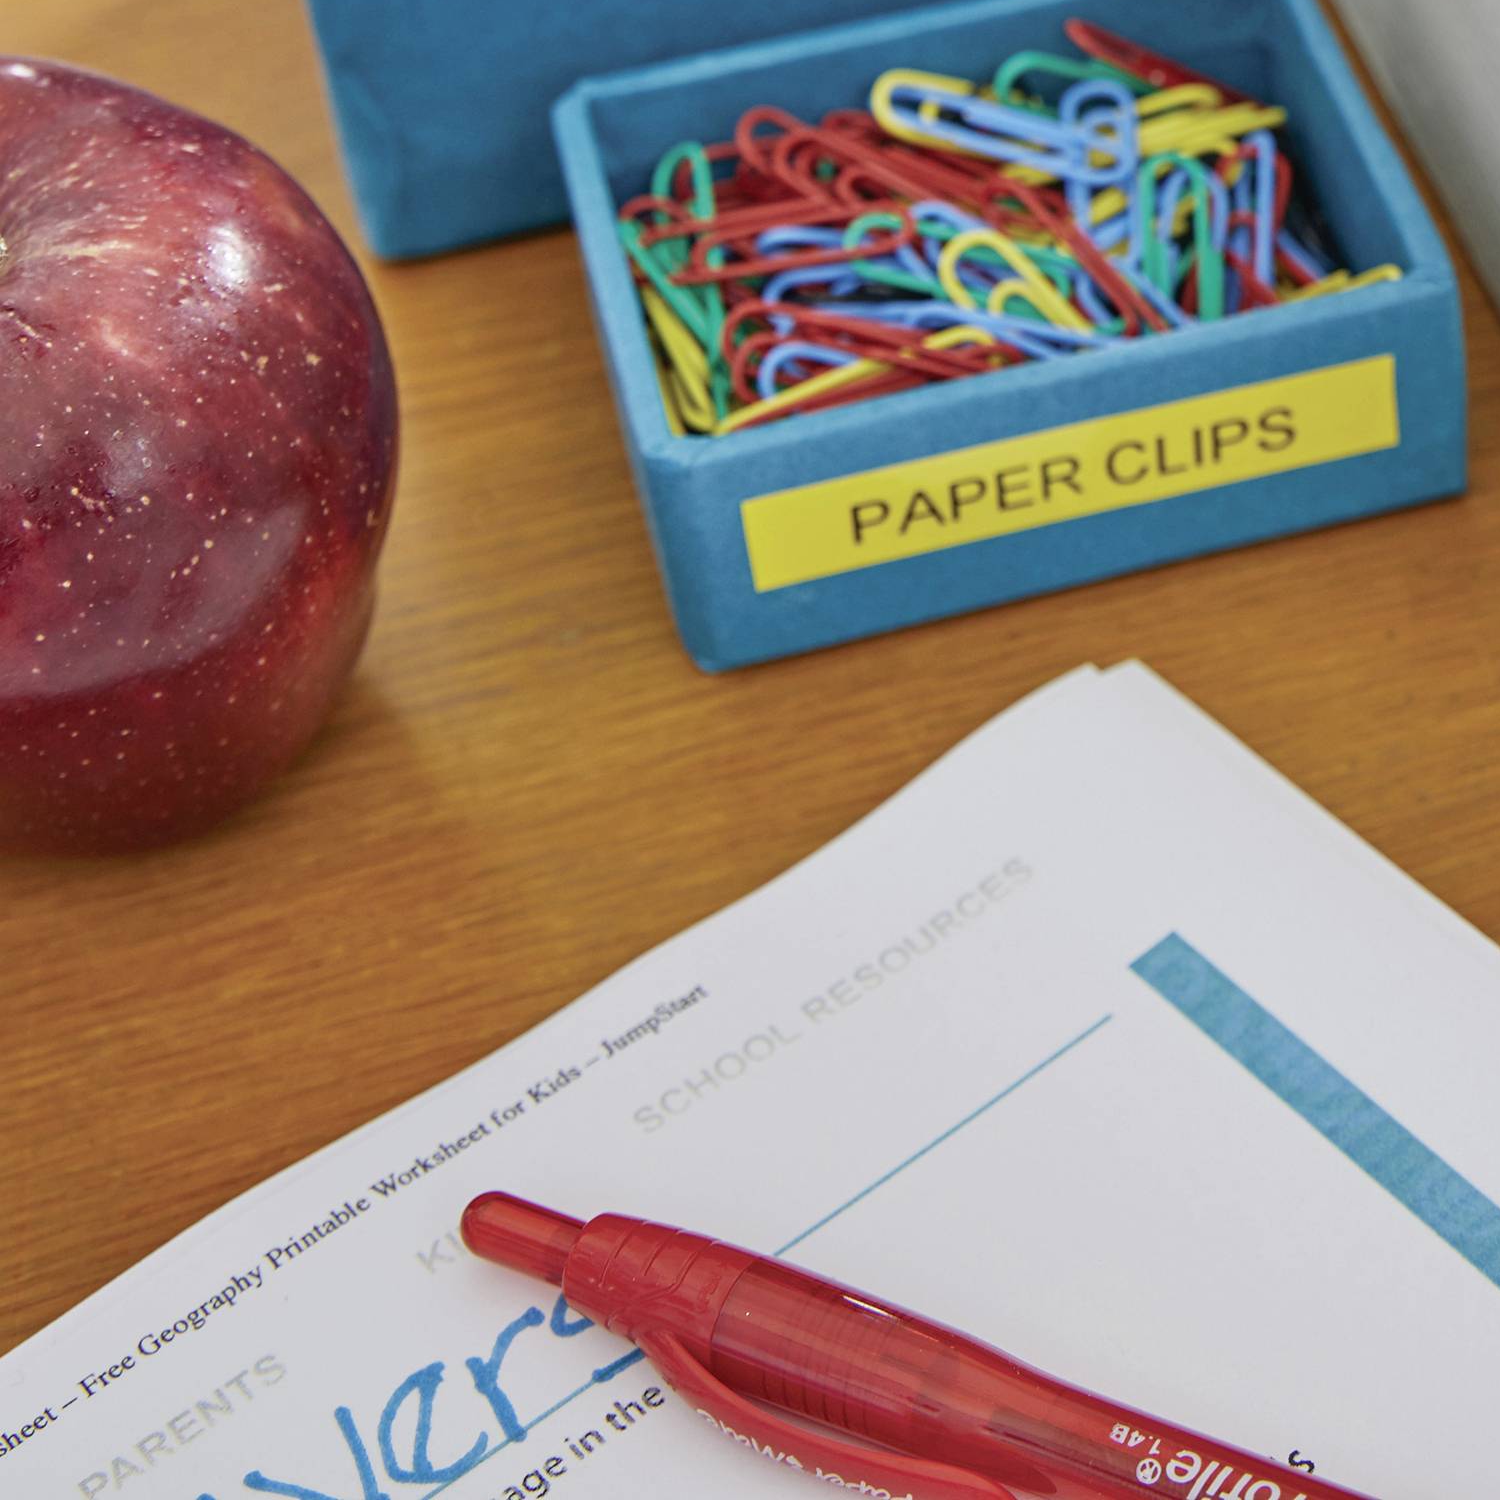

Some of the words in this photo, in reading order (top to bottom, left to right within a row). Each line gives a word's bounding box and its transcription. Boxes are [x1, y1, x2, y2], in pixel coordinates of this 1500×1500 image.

[849, 456, 1083, 545] PAPER
[1105, 406, 1298, 486] CLIPS
[632, 1023, 800, 1134] SCHOOL
[800, 856, 1034, 1025] RESOURCES
[79, 1355, 136, 1398] Free
[137, 1265, 264, 1357] Geography
[264, 1196, 371, 1270] Printable
[371, 1122, 492, 1198] Worksheet
[491, 1100, 527, 1131] for
[527, 1063, 583, 1105] Kids
[600, 984, 709, 1059] JumpStart
[78, 1353, 289, 1500] PARENTS
[563, 1429, 607, 1460] in
[605, 1386, 667, 1432] the
[1108, 1422, 1162, 1455] 1.4B
